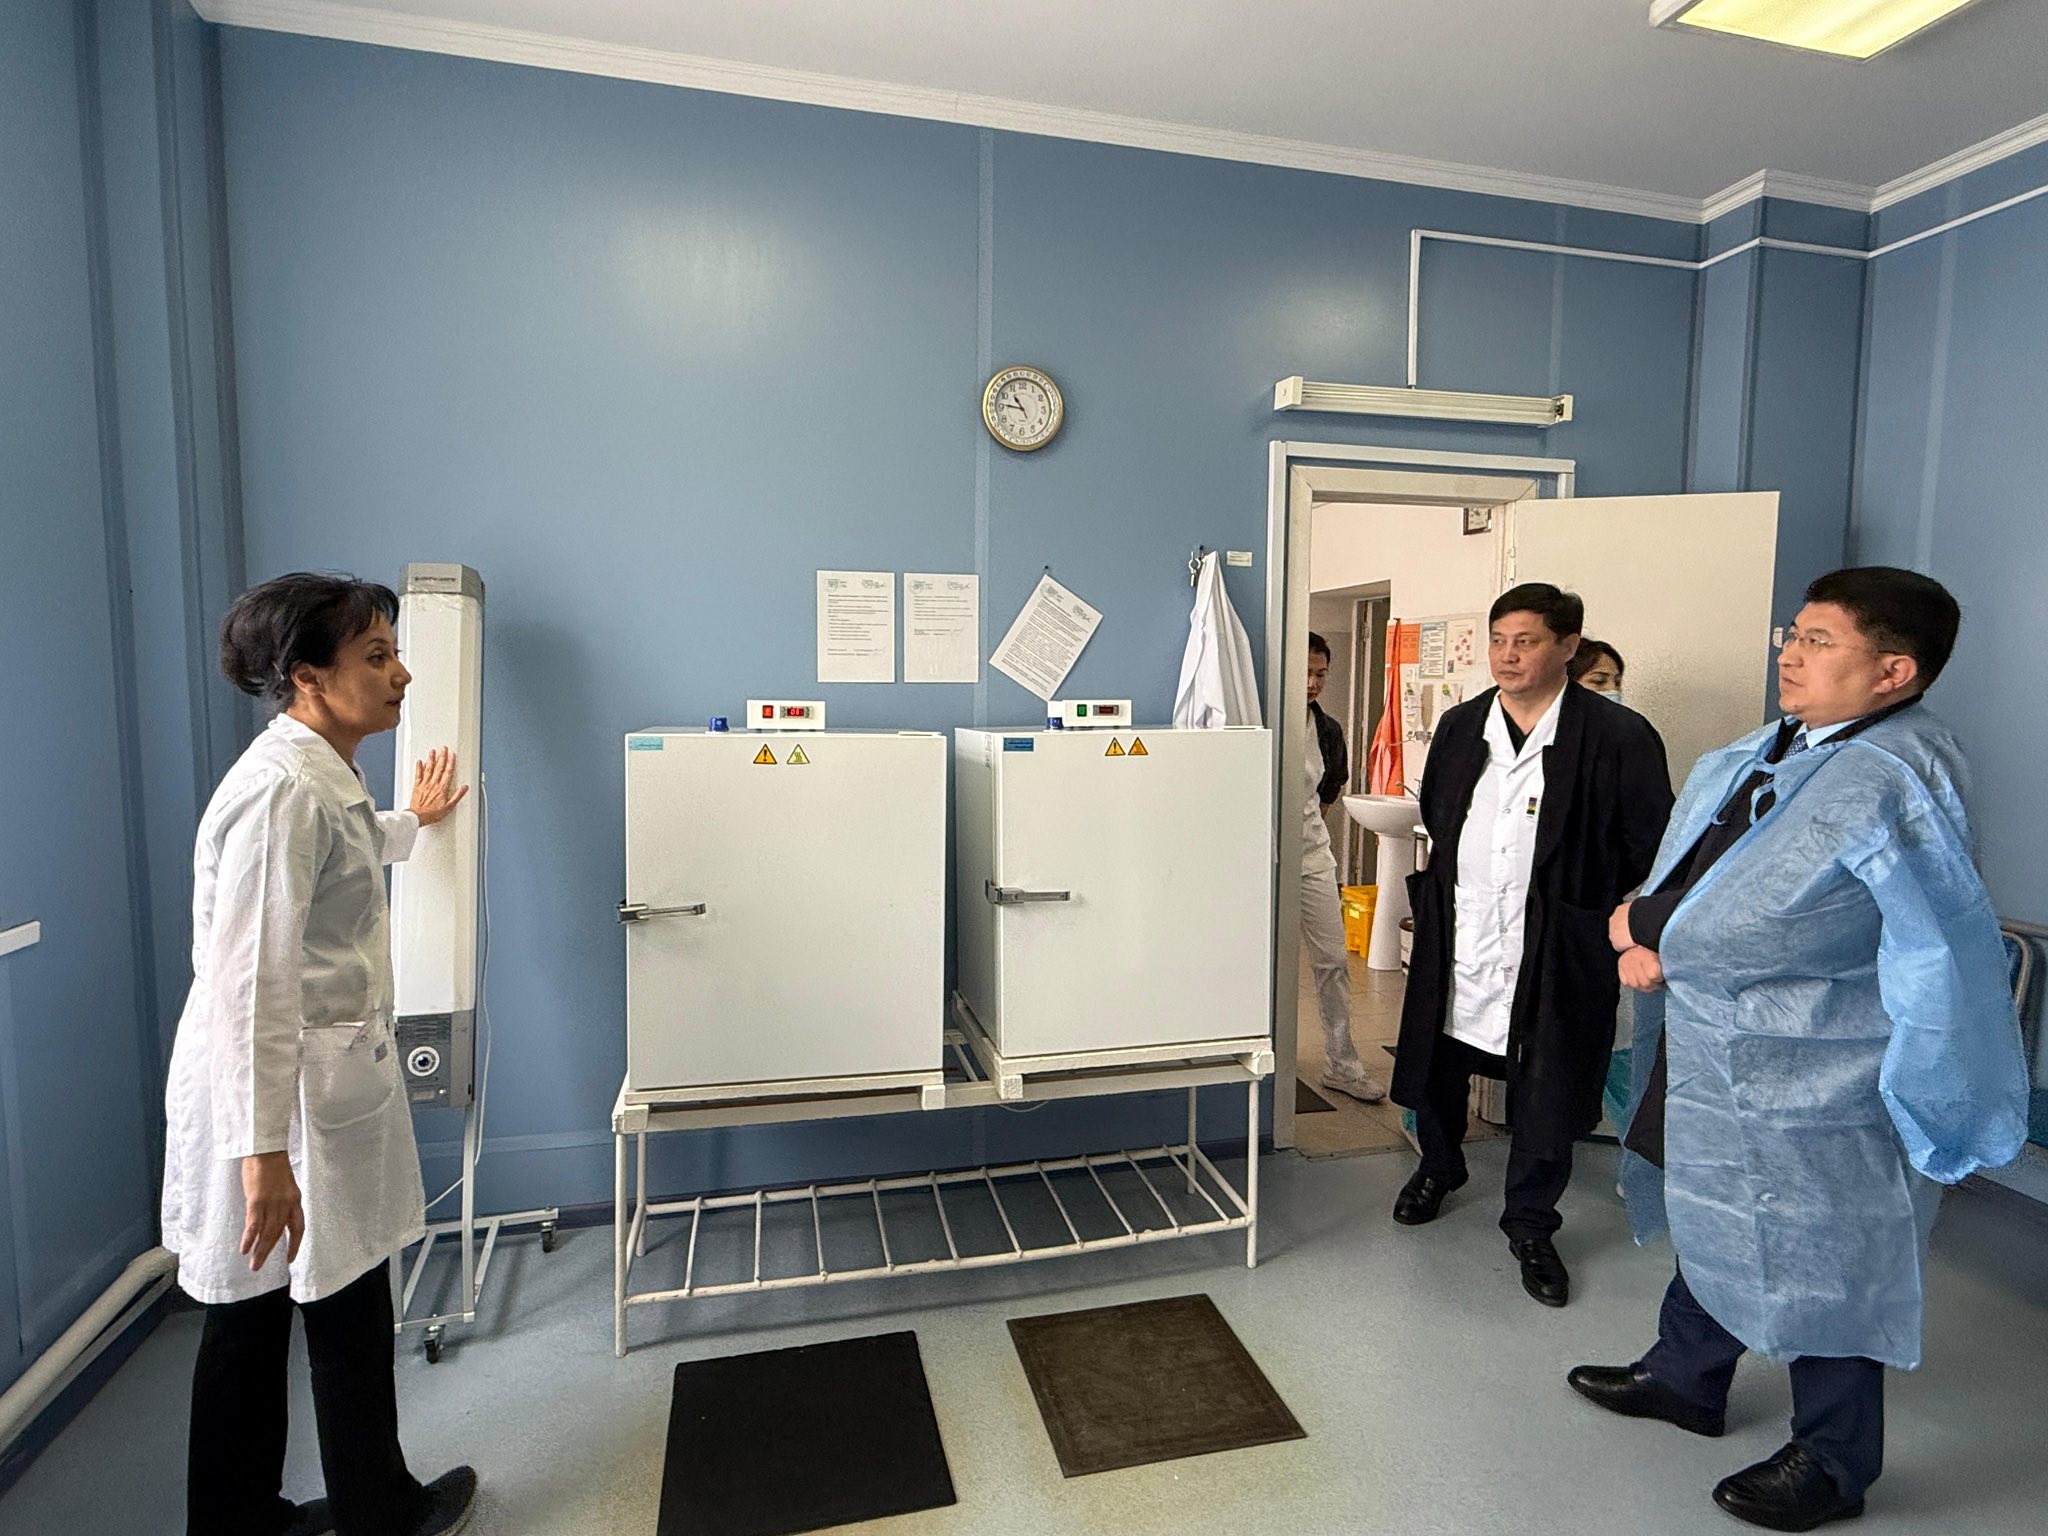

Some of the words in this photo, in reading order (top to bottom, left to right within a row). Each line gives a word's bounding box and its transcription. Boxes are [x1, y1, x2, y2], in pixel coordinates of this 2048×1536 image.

[1009, 384, 1016, 392] 11
[1018, 382, 1027, 390] 12
[1031, 385, 1035, 393] 1
[1001, 392, 1008, 400] 10
[1038, 394, 1043, 402] 2
[999, 403, 1004, 411] 9
[1041, 406, 1046, 415] 3
[1002, 415, 1007, 423] 8
[1010, 424, 1015, 432] 7
[1019, 427, 1025, 436] 6
[1030, 425, 1035, 434] 5
